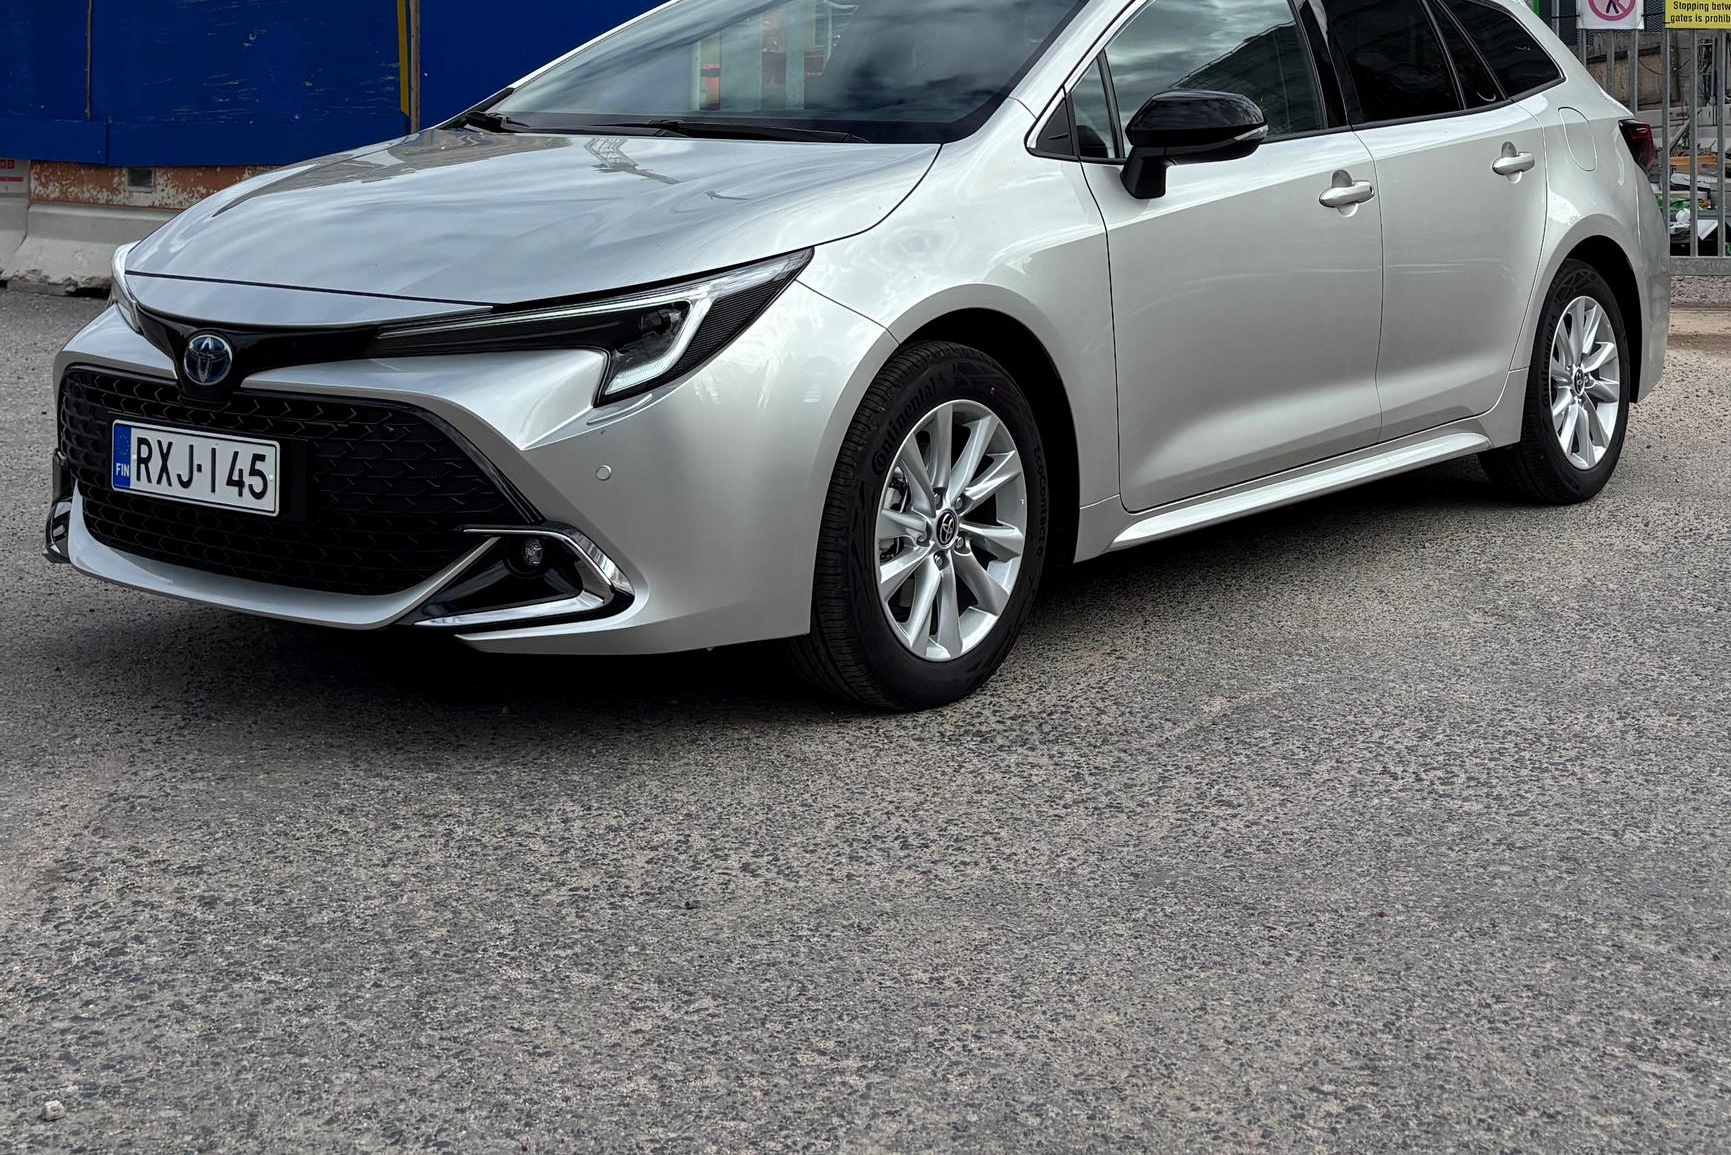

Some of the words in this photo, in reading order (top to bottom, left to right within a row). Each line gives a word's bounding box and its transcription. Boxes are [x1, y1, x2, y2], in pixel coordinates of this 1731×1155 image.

[1670, 13, 1693, 23] gates
[1695, 14, 1703, 23] is
[1705, 14, 1731, 24] prohib
[1673, 1, 1709, 12] Stopping
[872, 376, 937, 476] Continental
[116, 462, 130, 478] FIN
[136, 436, 269, 500] RXJ-145
[1033, 445, 1047, 543] EcoContact
